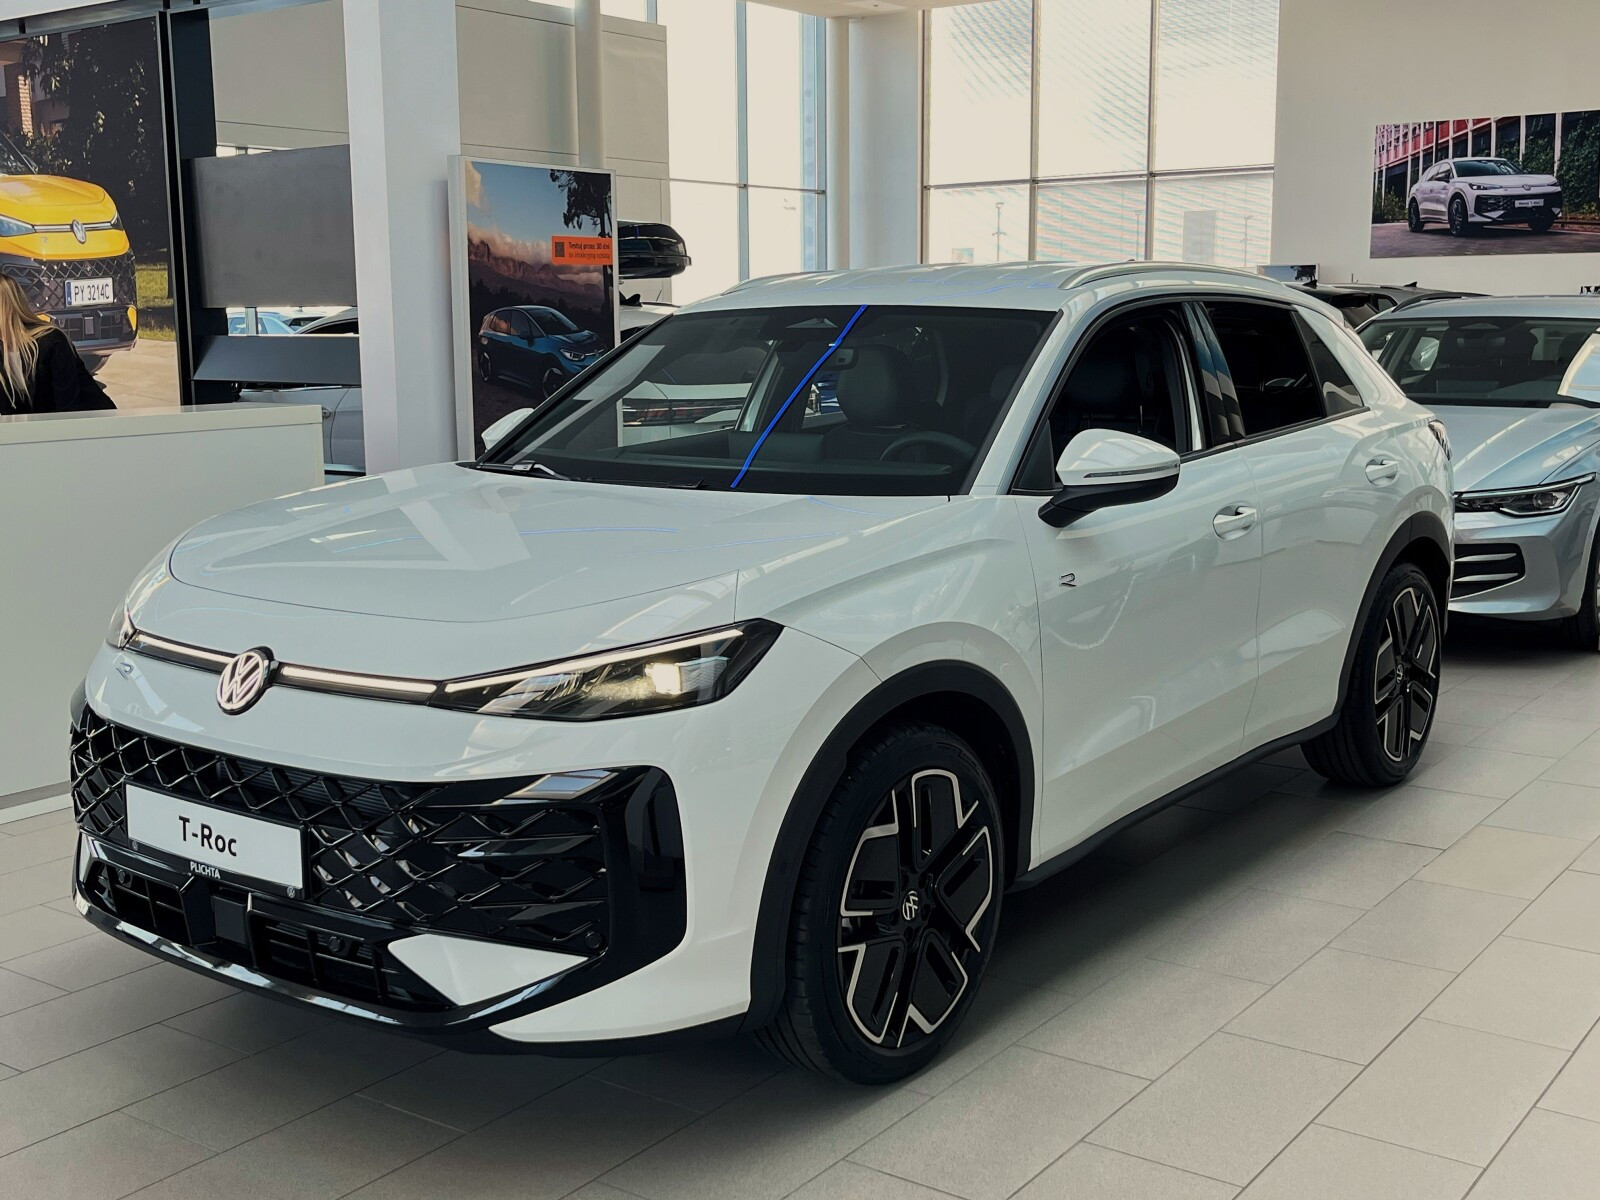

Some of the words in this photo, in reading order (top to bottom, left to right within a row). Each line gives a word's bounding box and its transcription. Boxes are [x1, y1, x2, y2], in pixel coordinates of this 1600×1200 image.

[74, 285, 84, 302] PY
[87, 283, 109, 301] 3214C
[178, 815, 238, 857] T-Roc
[190, 861, 220, 879] PLICHTA
